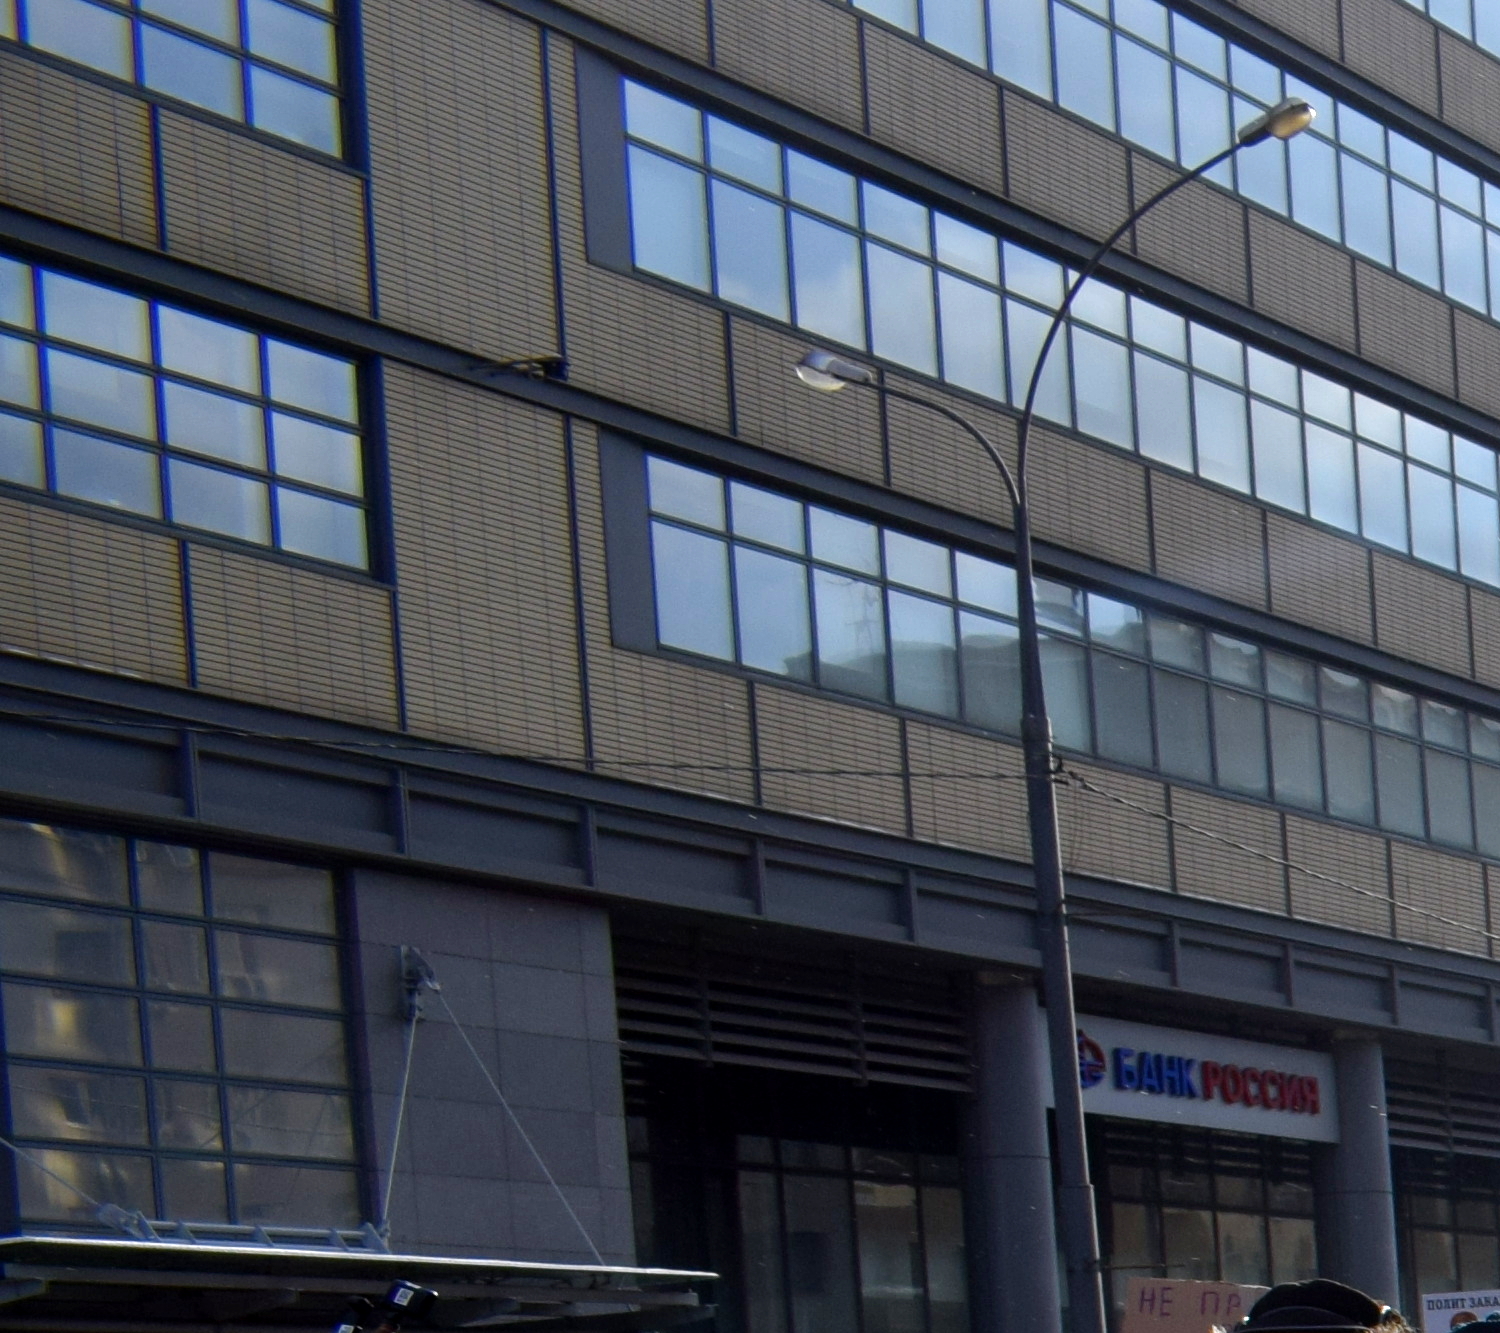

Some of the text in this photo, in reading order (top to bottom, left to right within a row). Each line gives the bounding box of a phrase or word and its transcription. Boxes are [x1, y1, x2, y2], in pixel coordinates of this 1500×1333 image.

[1113, 1047, 1321, 1115] БАНК РОССИЯ
[1139, 1286, 1174, 1316] НЕ
[1427, 1298, 1466, 1311] ПОЛИТ
